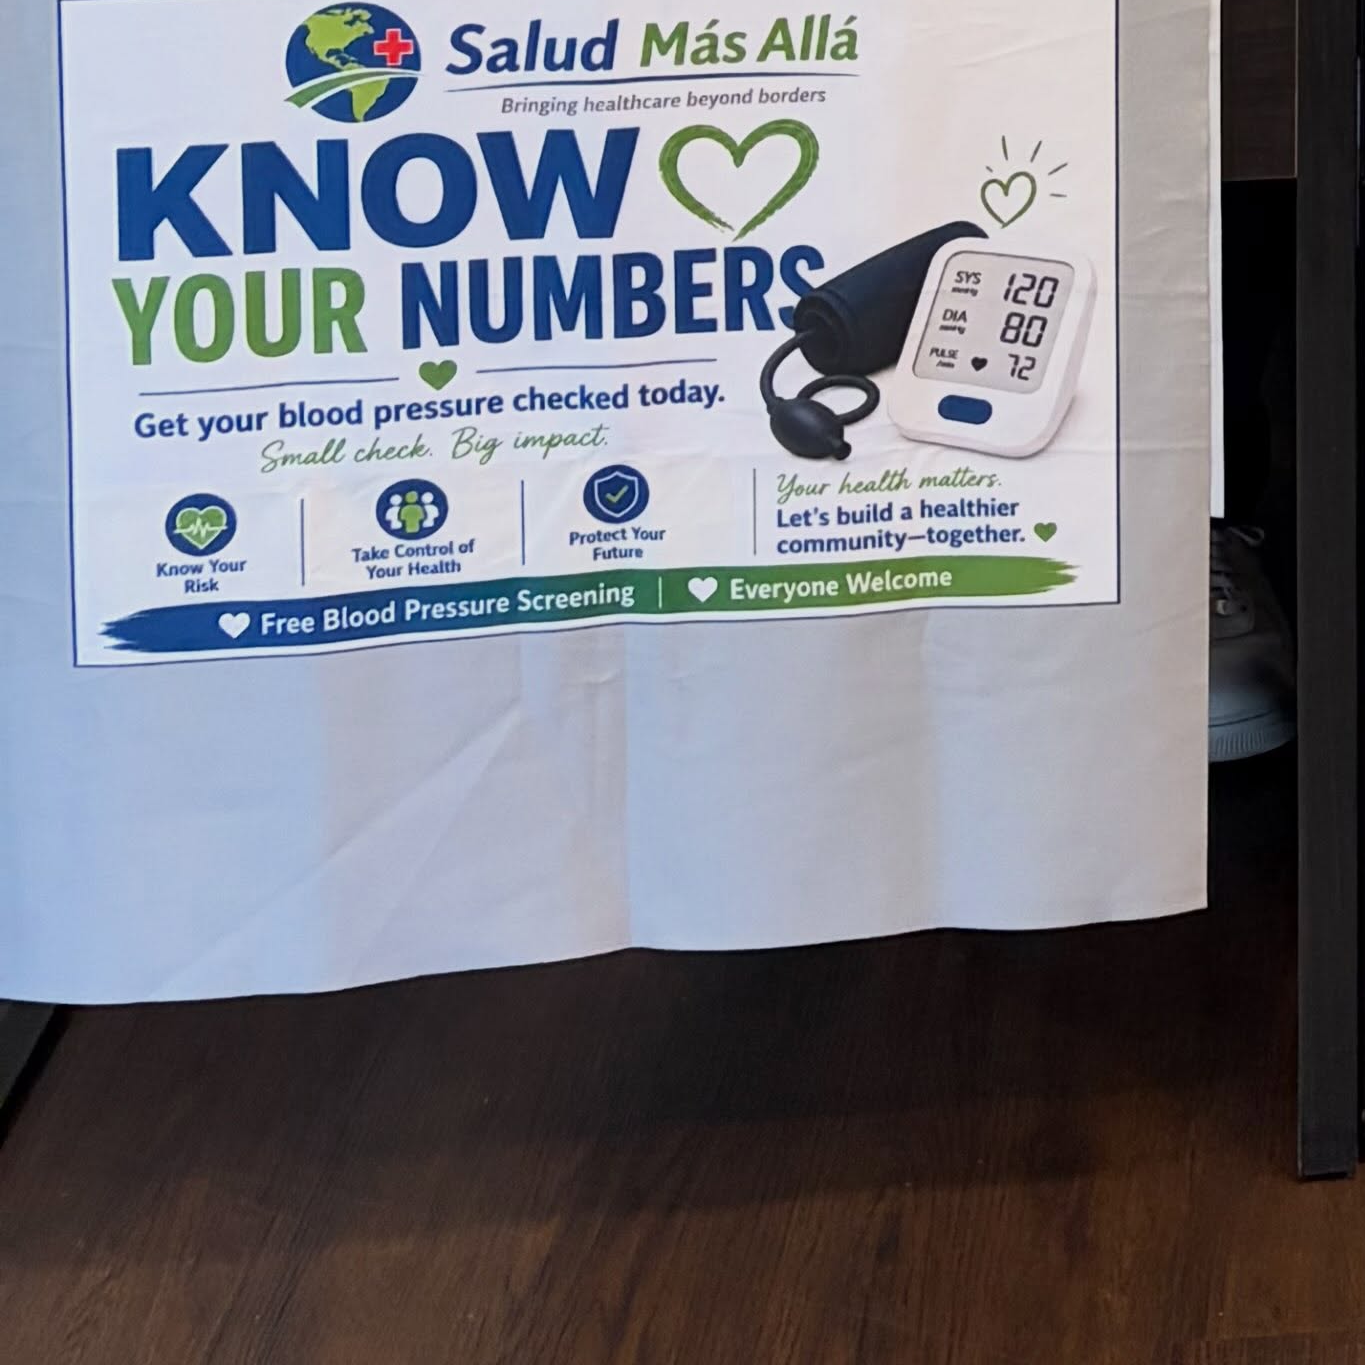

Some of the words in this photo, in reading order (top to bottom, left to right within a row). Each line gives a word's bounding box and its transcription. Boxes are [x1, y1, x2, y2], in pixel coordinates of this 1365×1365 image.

[446, 19, 620, 76] Salud
[638, 18, 748, 68] Más
[756, 14, 860, 64] Allá
[500, 95, 577, 118] Bringing
[583, 92, 681, 113] healthcare
[686, 90, 753, 112] beyond
[757, 86, 827, 105] borders
[115, 126, 641, 261] KNOW
[112, 264, 368, 366] YOUR
[402, 245, 825, 351] NUMBERS
[954, 271, 982, 285] SYS
[1003, 273, 1059, 308] 120
[942, 309, 967, 323] DIA
[1000, 312, 1048, 347] 80
[1008, 353, 1036, 381] 72
[134, 411, 188, 439] Get
[198, 410, 269, 441] your
[279, 398, 363, 429] blood
[373, 390, 504, 429] pressure
[513, 383, 630, 415] checked
[639, 379, 726, 410] today.
[261, 437, 347, 474] Small
[354, 433, 433, 464] check.
[451, 426, 504, 465] Big
[513, 422, 609, 452] impact.
[777, 472, 831, 505] Your
[839, 468, 911, 495] health
[919, 471, 1003, 492] matters.
[777, 507, 829, 529] Let's
[837, 502, 894, 524] build
[900, 507, 913, 520] a
[919, 498, 1019, 520] healthier
[352, 546, 389, 563] Take
[395, 541, 453, 560] Control
[456, 538, 475, 556] of
[568, 528, 627, 546] Protect
[631, 526, 666, 543] Your
[593, 545, 643, 560] Future
[156, 561, 204, 578] Know
[209, 557, 246, 575] Your
[366, 564, 403, 581] Your
[408, 558, 461, 576] Health
[185, 577, 220, 594] Risk
[730, 578, 839, 605] Everyone
[846, 570, 953, 595] Welcome
[261, 611, 315, 636] Free
[324, 602, 396, 631] Blood
[405, 593, 510, 622] Pressure
[516, 585, 635, 613] Screening
